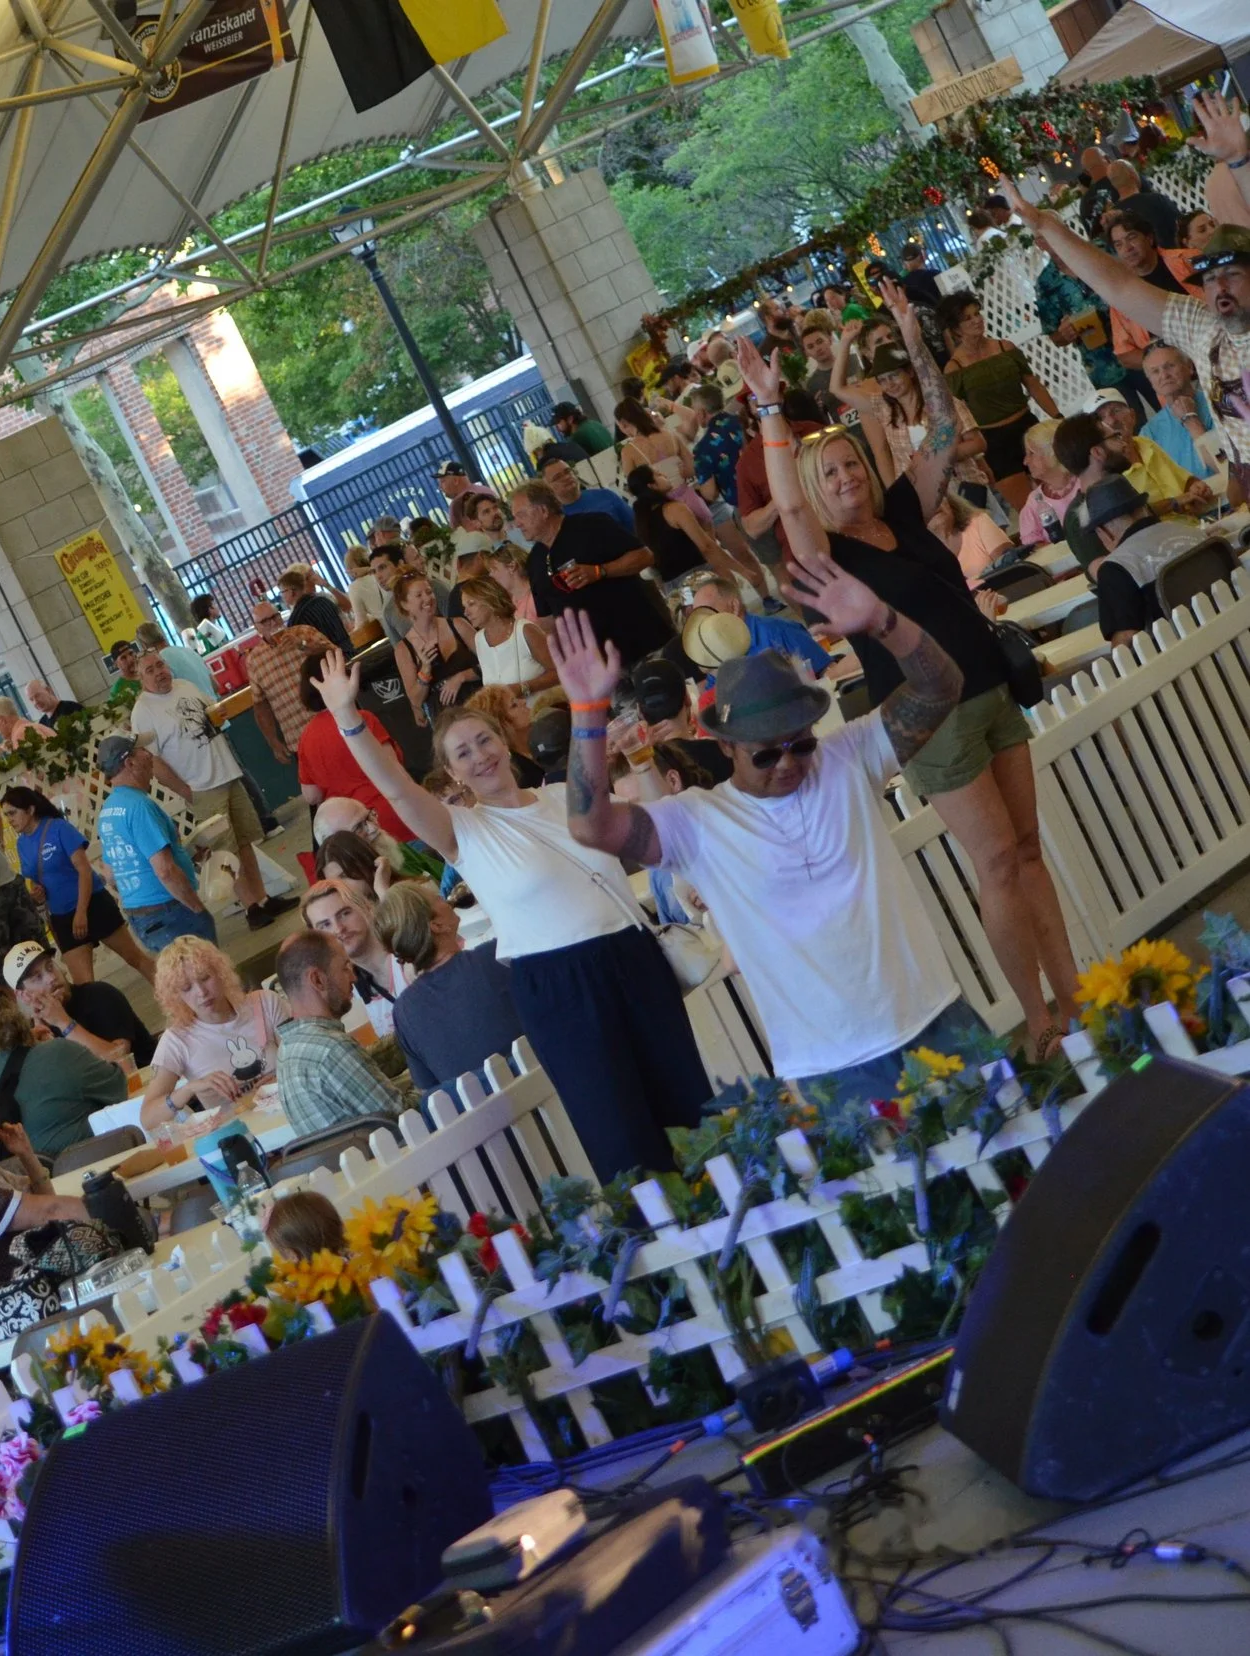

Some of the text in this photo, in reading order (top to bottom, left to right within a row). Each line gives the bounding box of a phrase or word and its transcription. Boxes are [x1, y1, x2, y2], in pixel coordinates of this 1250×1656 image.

[184, 7, 257, 47] ranziskaner
[203, 31, 244, 54] WEISSBIER
[934, 67, 1002, 112] WEINSTUBE
